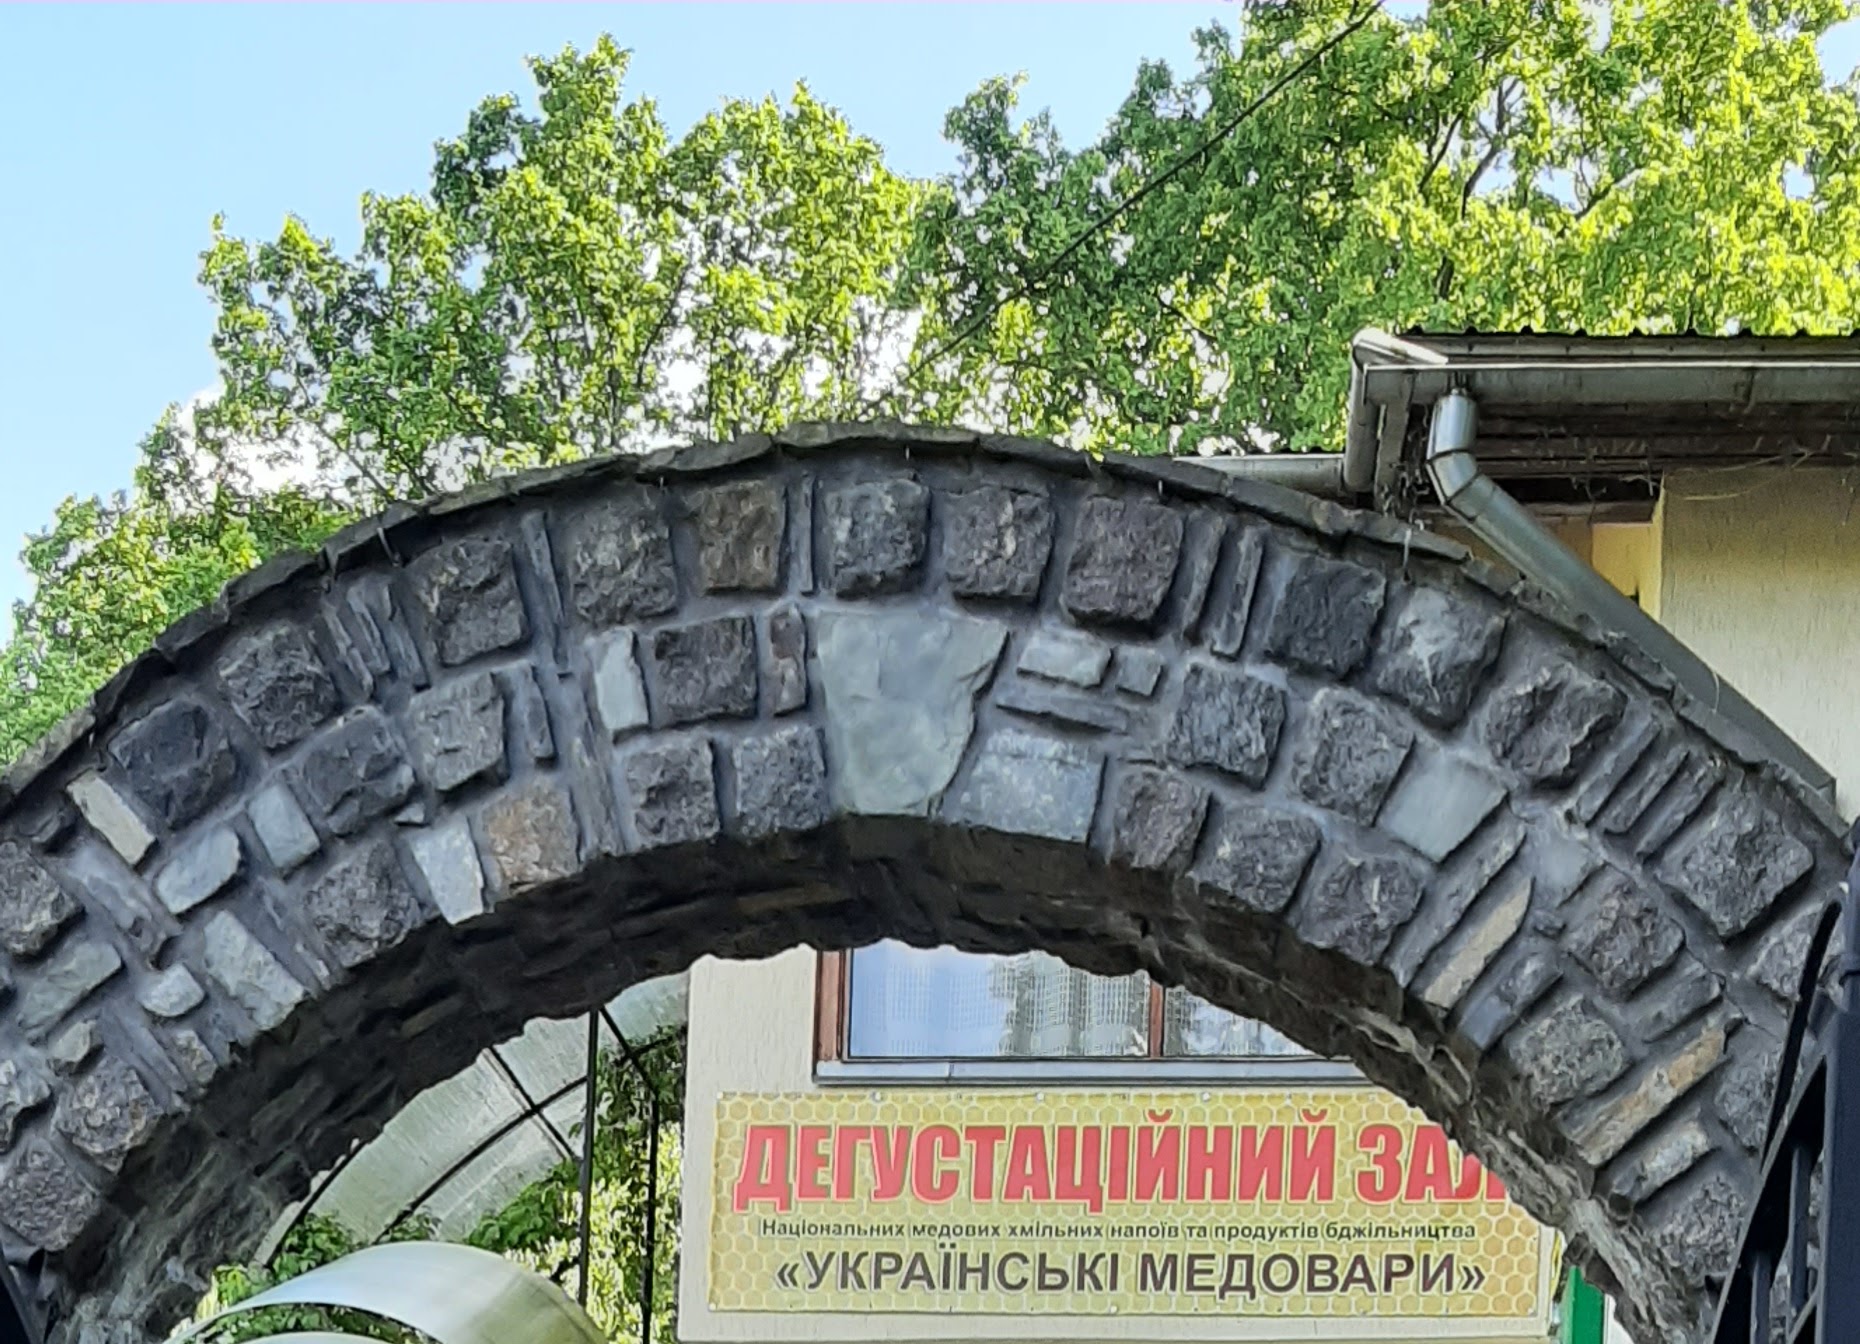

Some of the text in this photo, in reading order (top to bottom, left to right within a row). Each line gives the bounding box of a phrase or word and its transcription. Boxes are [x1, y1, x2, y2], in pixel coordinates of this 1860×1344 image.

[733, 1108, 1336, 1214] ДЕГУСТАЦІЙНИЙ
[761, 1218, 1476, 1242] Національних медових хмільних напоїв та продуктів бджільництва
[776, 1241, 1486, 1301] «УКРАЇНСЬКІ МЕДОВАРИ»
